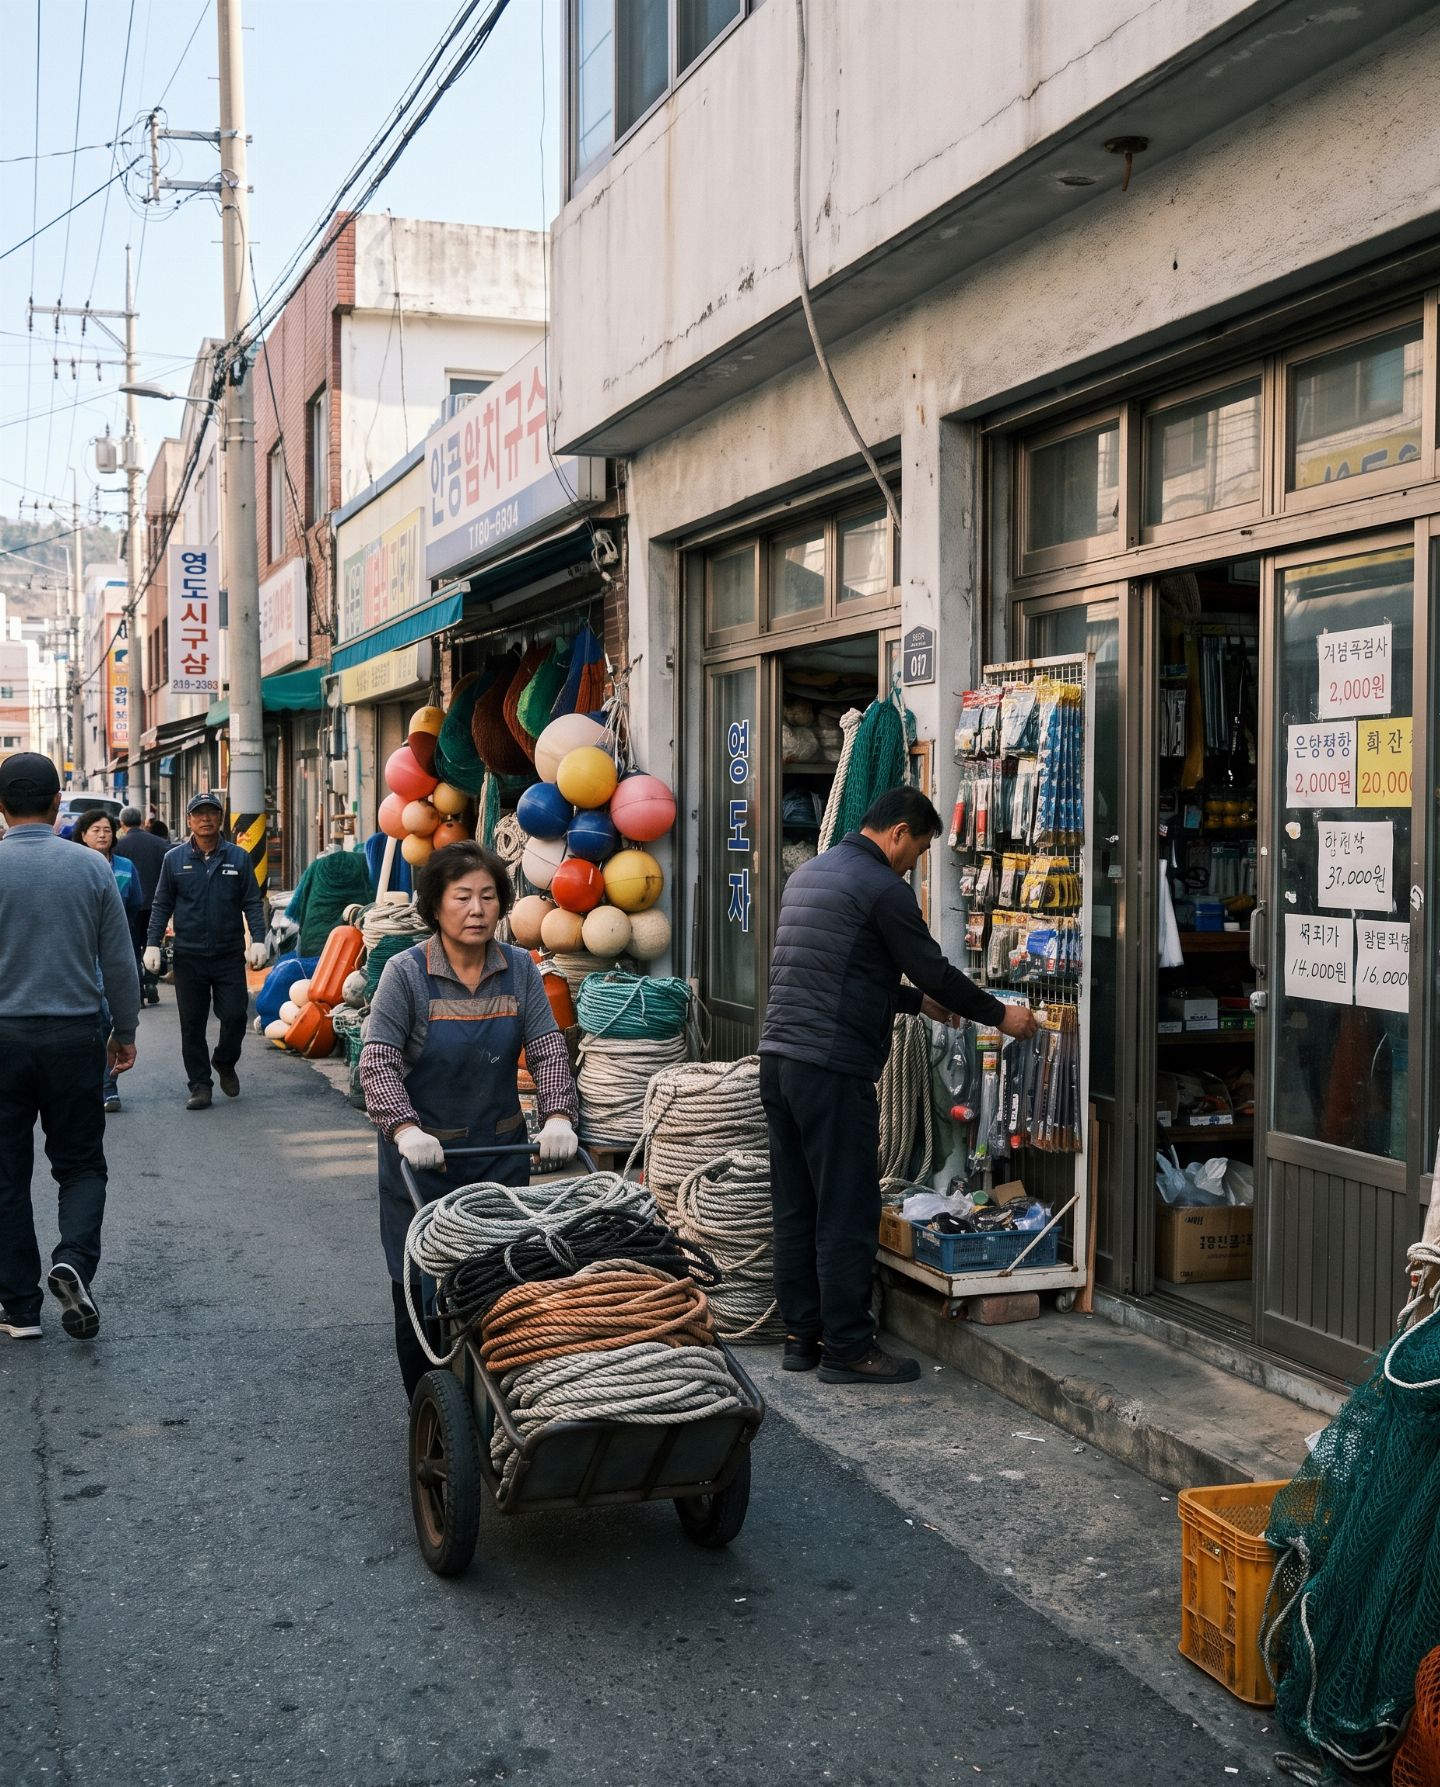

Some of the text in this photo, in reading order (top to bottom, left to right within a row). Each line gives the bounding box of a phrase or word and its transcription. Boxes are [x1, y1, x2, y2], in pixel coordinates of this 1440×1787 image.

[911, 654, 926, 677] 017
[1330, 674, 1384, 704] 2,000원
[1296, 770, 1351, 797] 2,000원
